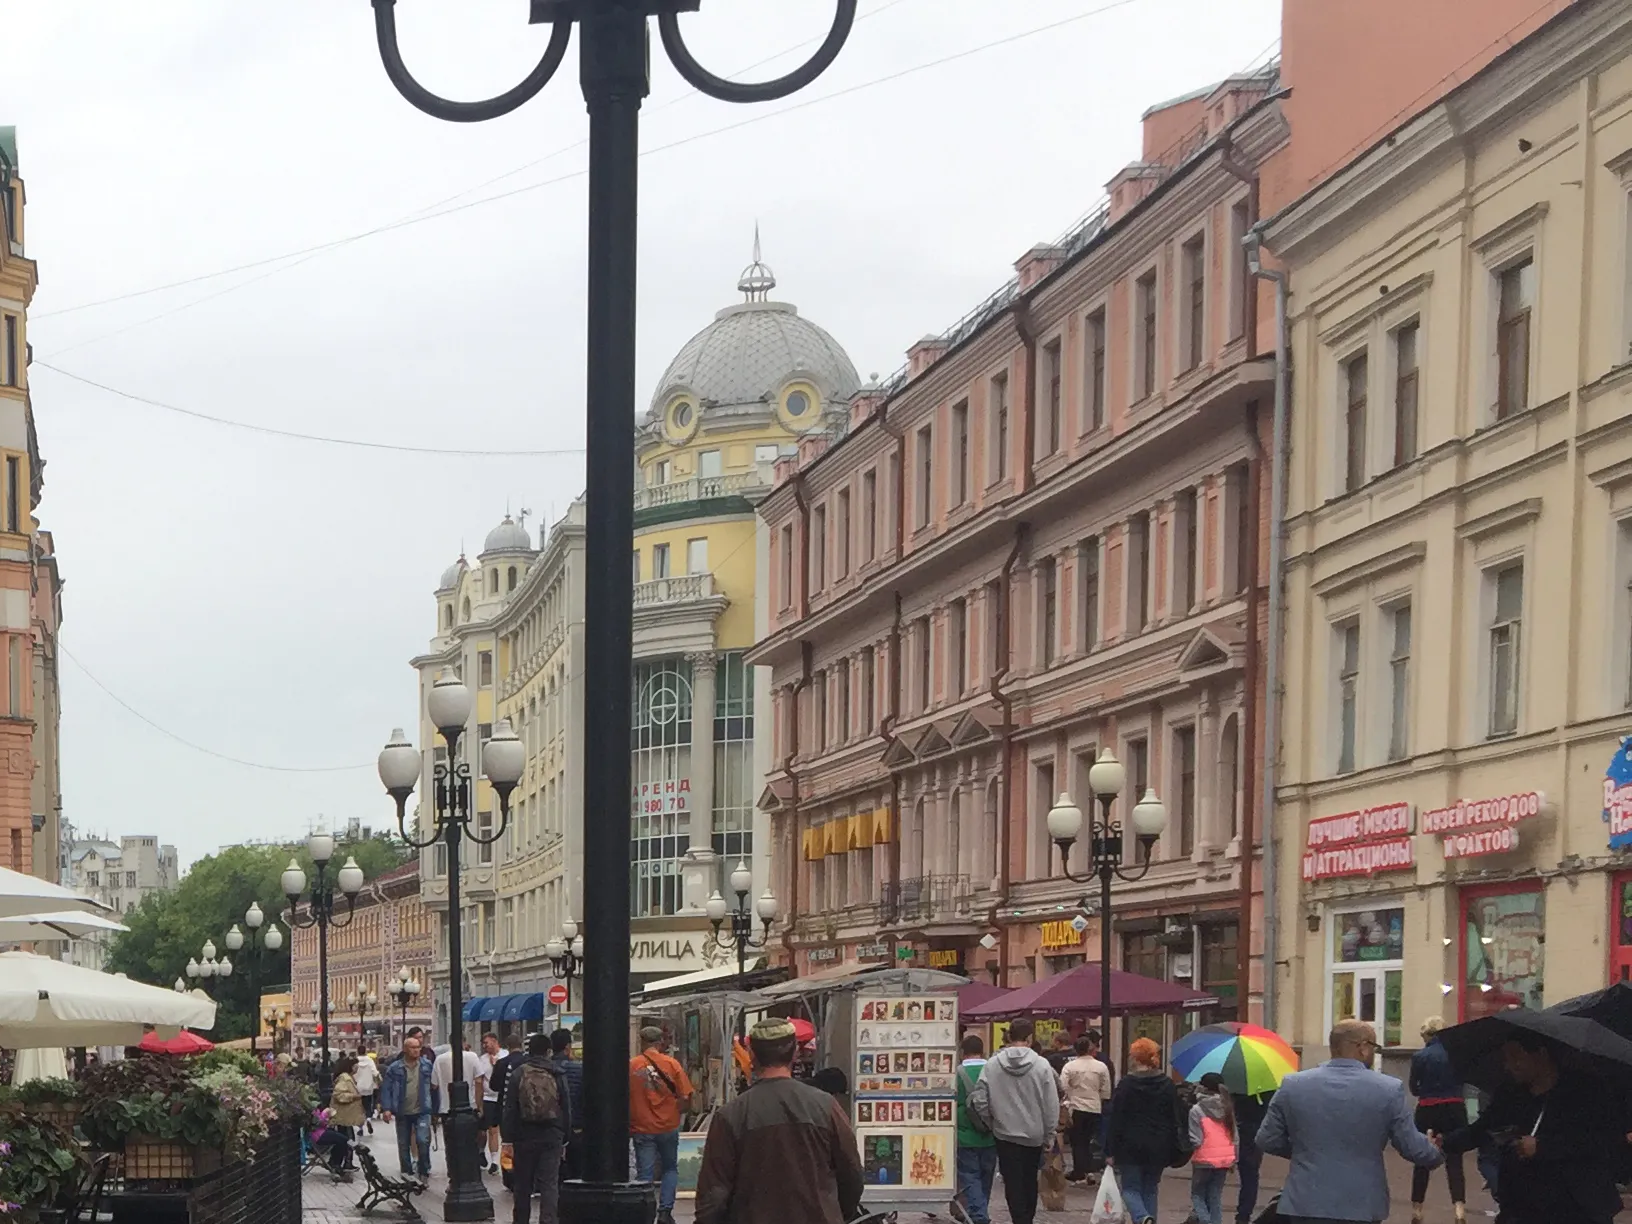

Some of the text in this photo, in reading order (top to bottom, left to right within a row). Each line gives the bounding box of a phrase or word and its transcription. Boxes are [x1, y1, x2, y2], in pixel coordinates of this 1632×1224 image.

[1422, 793, 1539, 833] МУЗЕЙ РЕКОРДОВ
[1307, 814, 1361, 846] ЛУЧШИЕ
[1443, 828, 1510, 858] И ФАКТОВ
[1303, 840, 1412, 879] И АТТРАКЦИОНЫ
[629, 939, 696, 961] УЛИЦА
